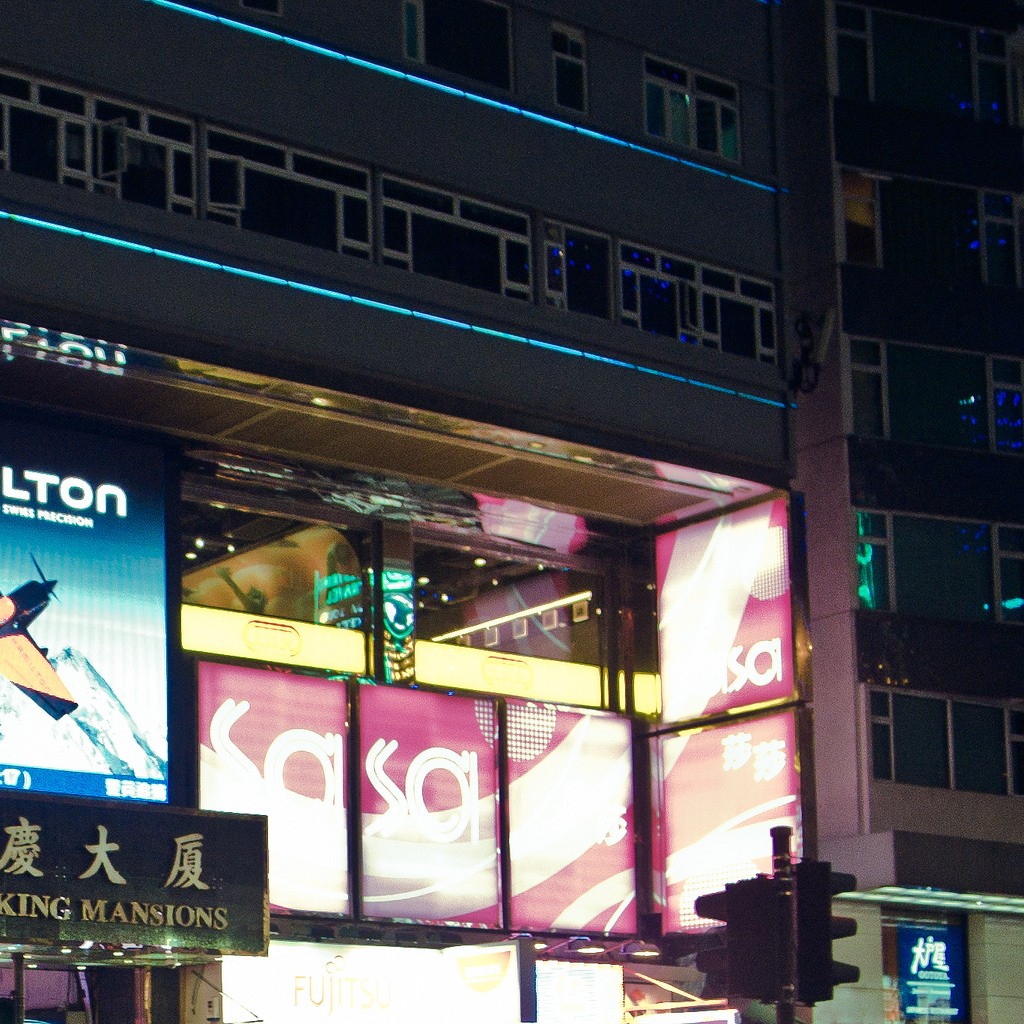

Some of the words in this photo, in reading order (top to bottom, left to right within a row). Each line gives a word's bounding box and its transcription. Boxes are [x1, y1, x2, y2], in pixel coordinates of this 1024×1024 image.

[2, 502, 36, 519] SWISS
[37, 508, 95, 530] PRECISION
[80, 899, 229, 931] MANSIONS
[293, 974, 393, 1018] FUJITSU
